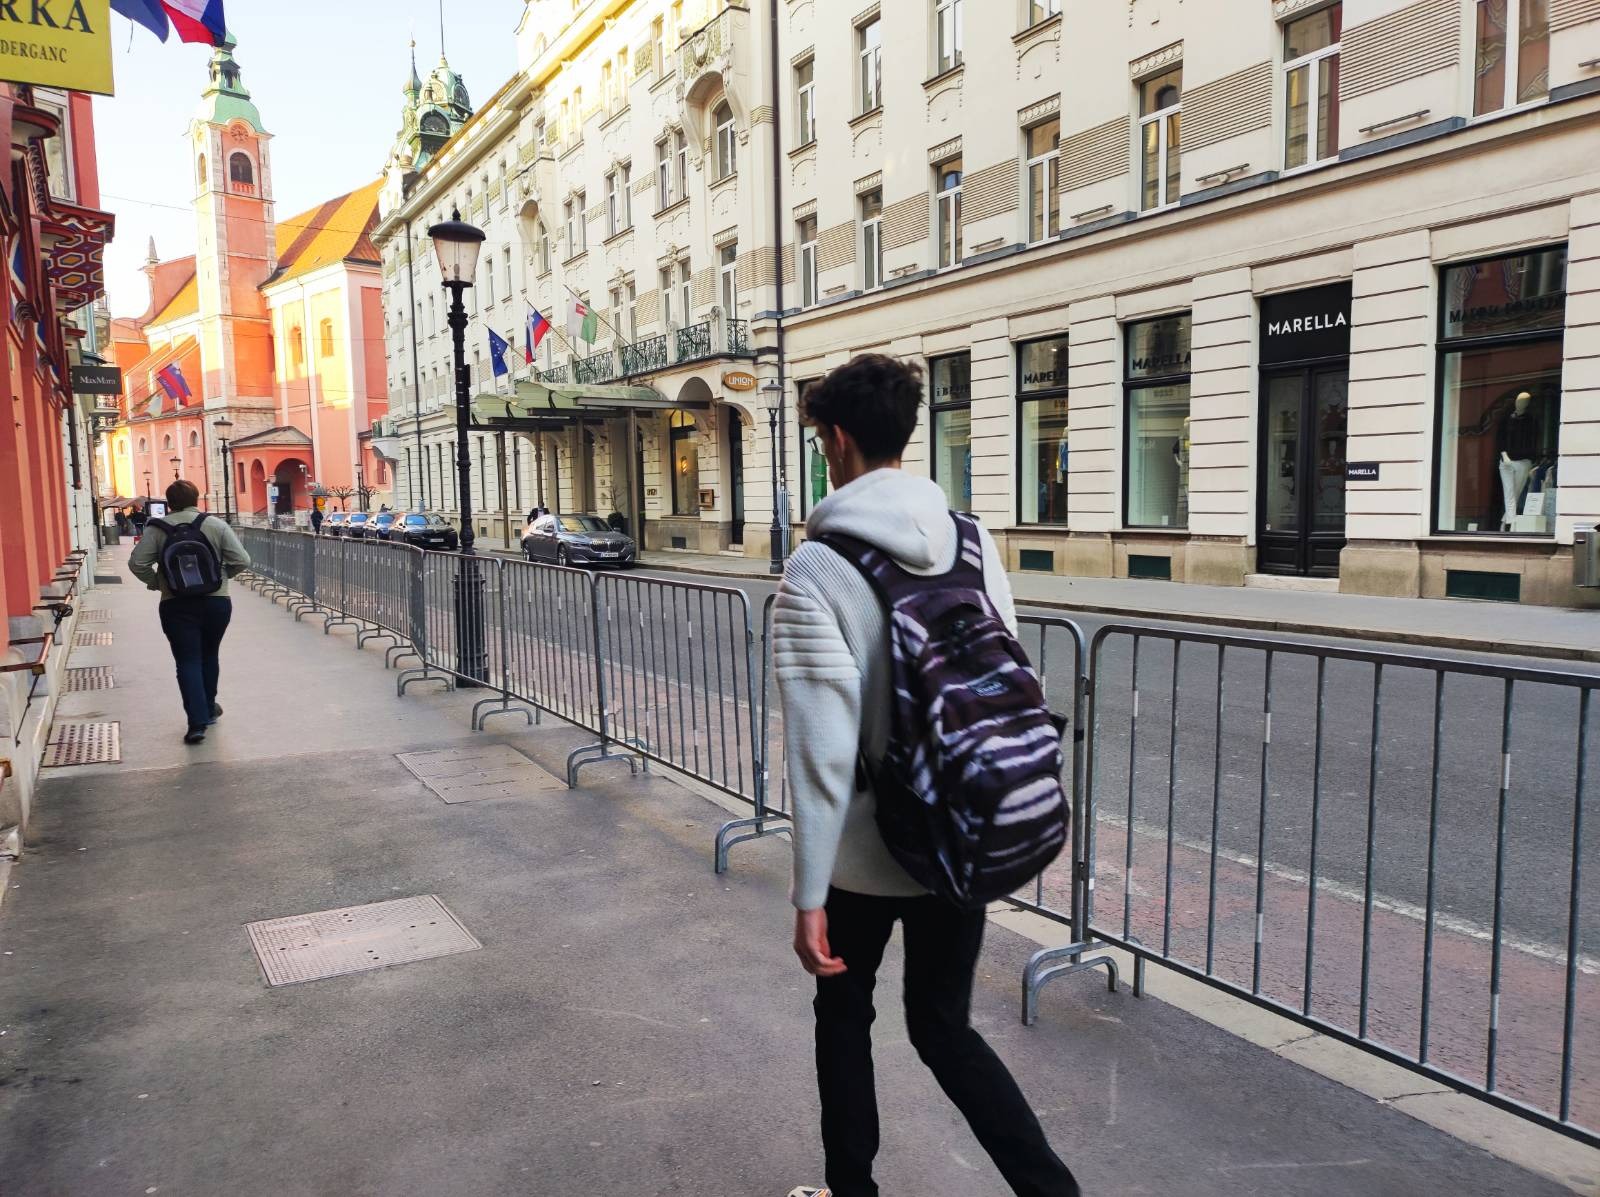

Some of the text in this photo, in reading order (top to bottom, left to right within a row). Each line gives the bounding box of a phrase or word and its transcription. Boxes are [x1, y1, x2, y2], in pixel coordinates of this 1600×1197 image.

[0, 40, 67, 63] DERGANC
[1268, 311, 1347, 336] MARELLA
[728, 376, 754, 386] UNION
